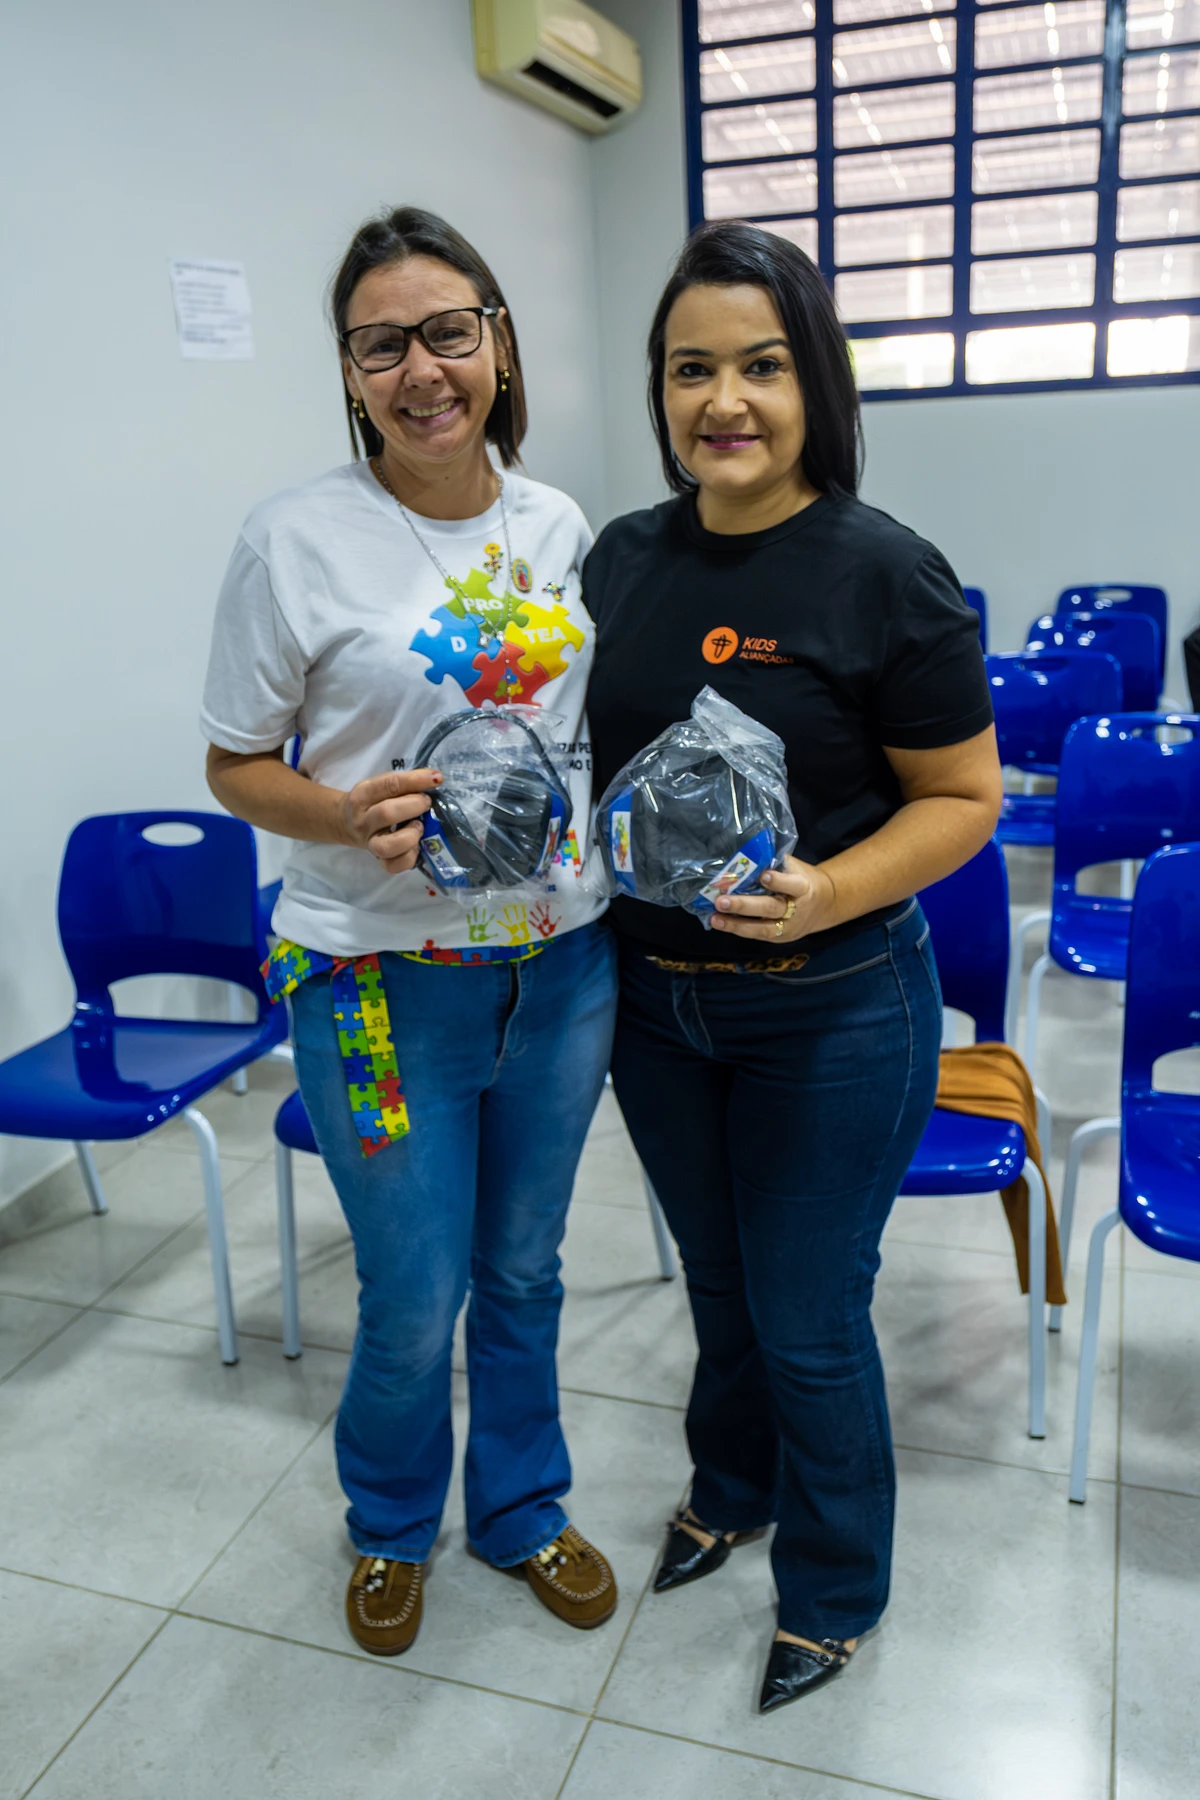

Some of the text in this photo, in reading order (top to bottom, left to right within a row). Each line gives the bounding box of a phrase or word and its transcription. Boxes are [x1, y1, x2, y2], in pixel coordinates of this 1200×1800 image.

[462, 597, 504, 612] PRO
[523, 627, 566, 644] TEA
[451, 636, 466, 653] D
[742, 636, 777, 652] KIDS
